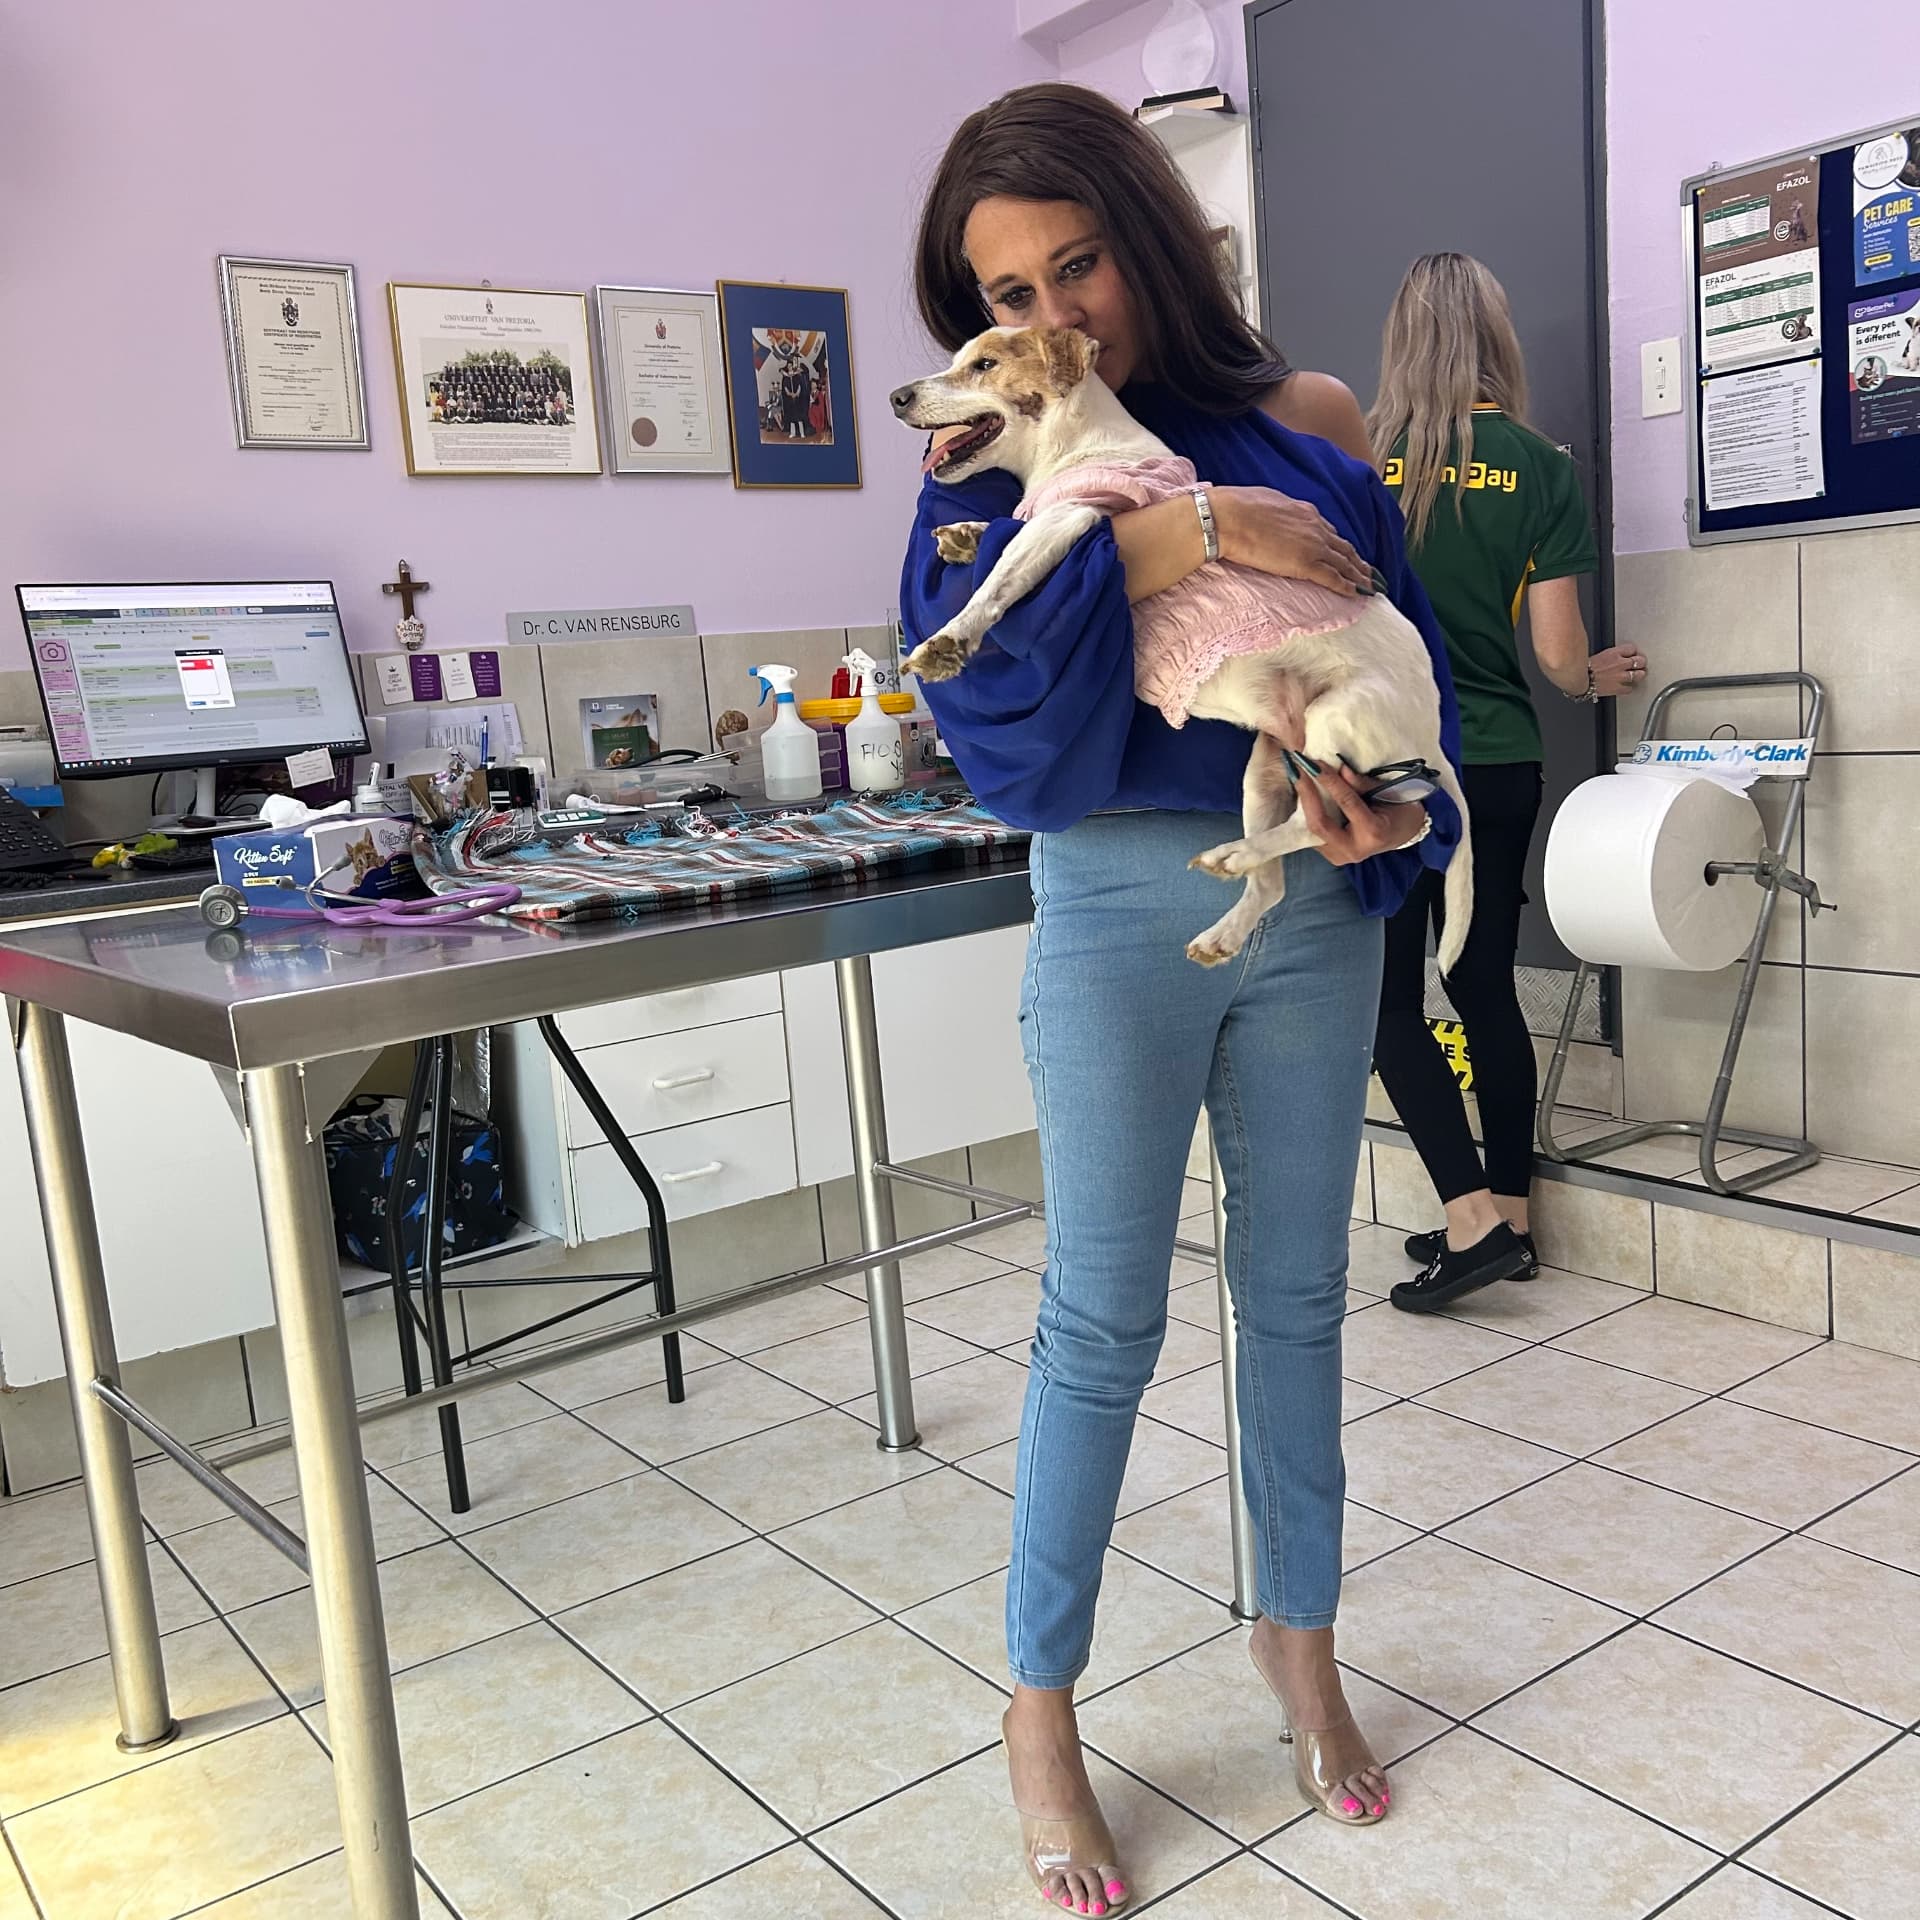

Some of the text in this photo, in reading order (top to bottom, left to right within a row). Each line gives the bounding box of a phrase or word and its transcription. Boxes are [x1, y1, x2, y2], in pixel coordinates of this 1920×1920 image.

[1776, 176, 1811, 192] EFAZOL
[1863, 197, 1914, 221] PET CARE
[1862, 216, 1898, 232] Services
[1705, 272, 1736, 287] EFAZOL
[1856, 320, 1896, 334] Every pet
[1856, 330, 1901, 345] is different
[1461, 462, 1518, 493] Pay
[523, 614, 681, 636] Dr. C. VAN RENSBURG
[233, 847, 269, 871] Kitten
